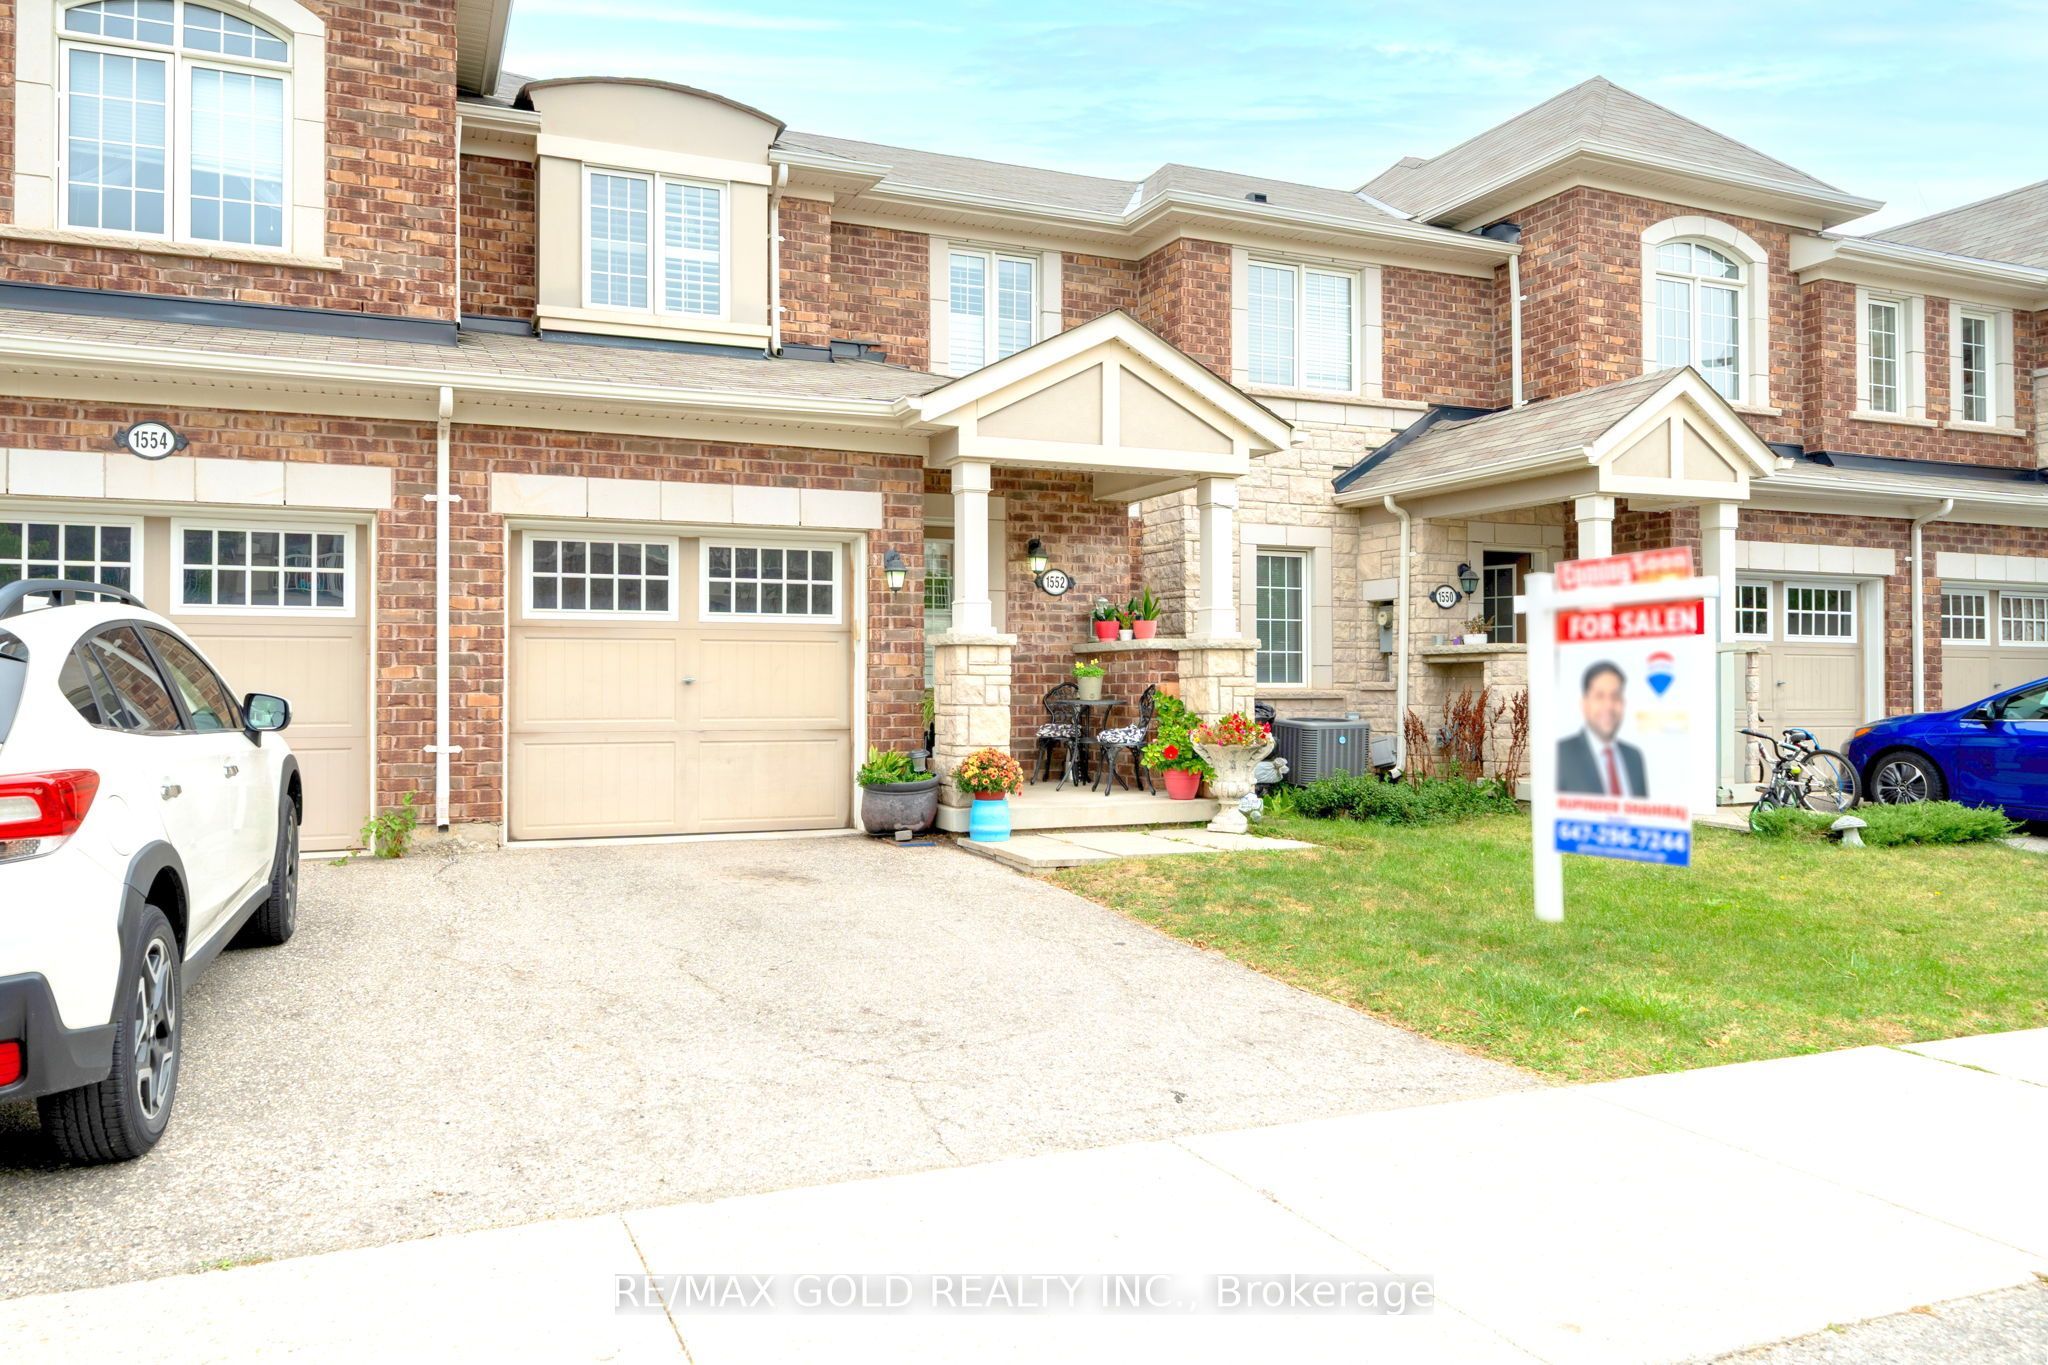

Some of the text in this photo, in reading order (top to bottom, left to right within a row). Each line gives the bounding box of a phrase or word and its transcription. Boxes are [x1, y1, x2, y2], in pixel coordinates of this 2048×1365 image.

[133, 430, 168, 449] 1554
[1046, 575, 1065, 589] 1552
[1438, 591, 1454, 602] 1550
[1567, 614, 1616, 639] FOR
